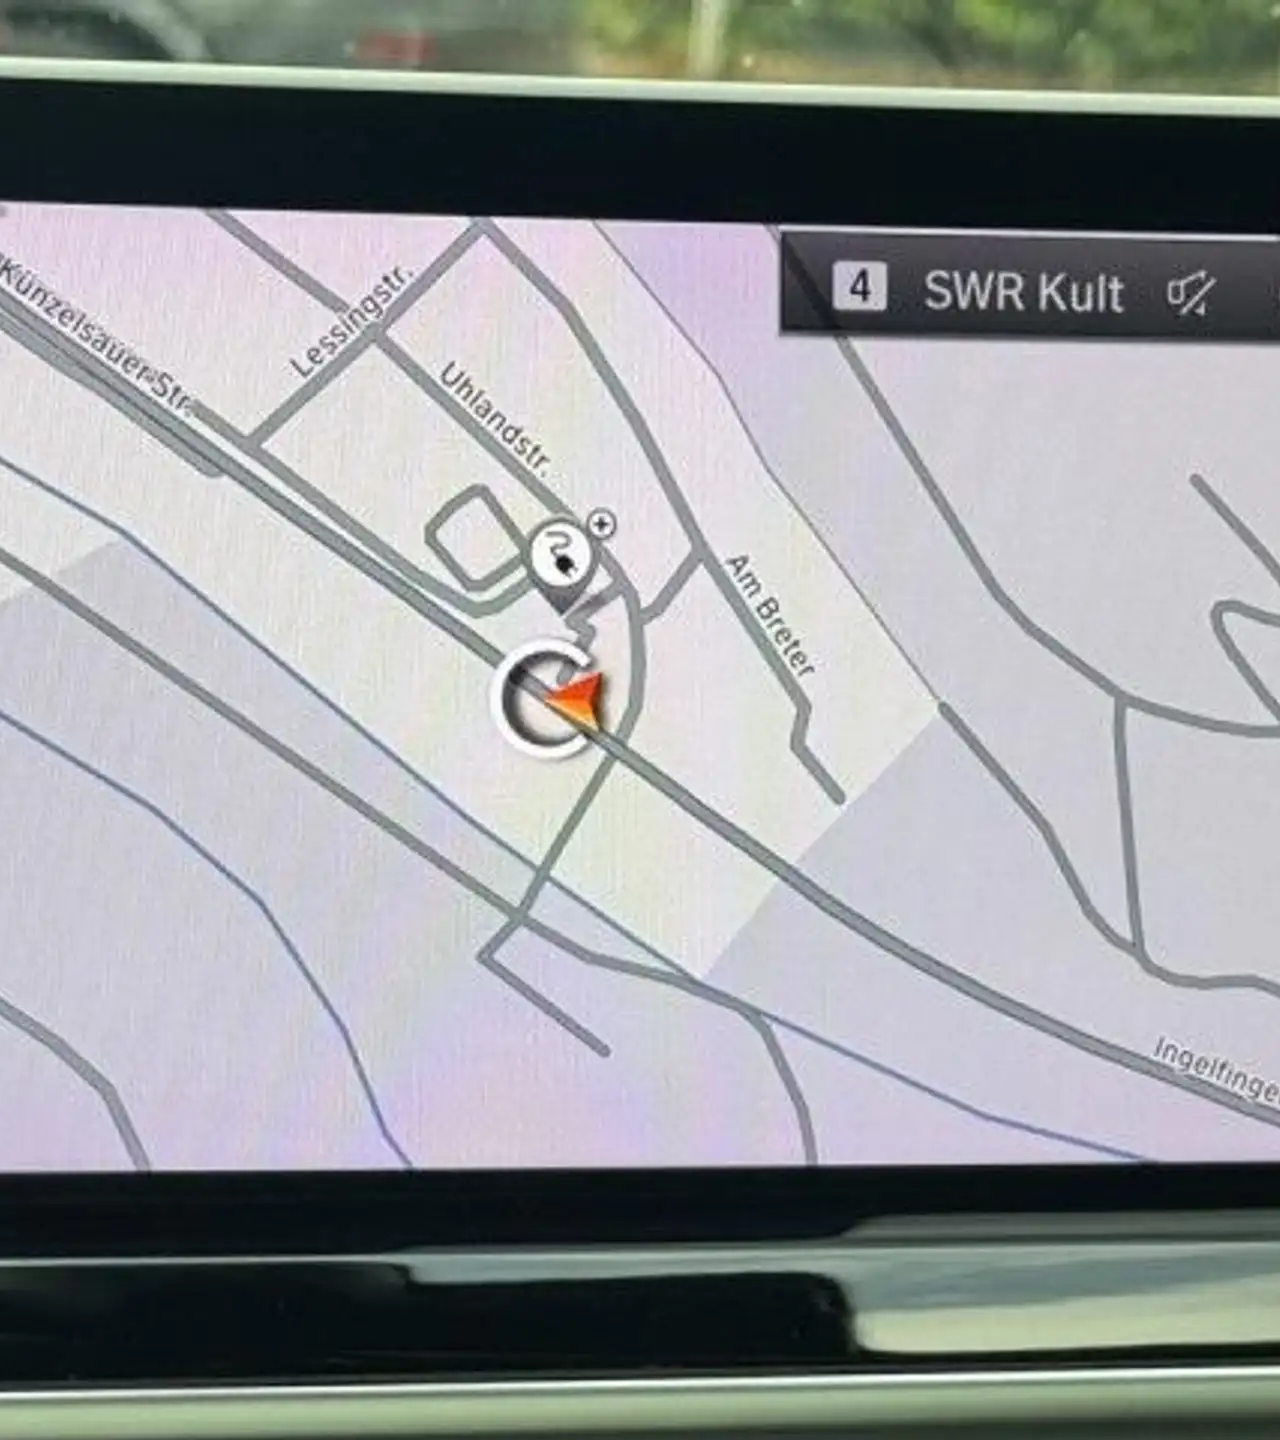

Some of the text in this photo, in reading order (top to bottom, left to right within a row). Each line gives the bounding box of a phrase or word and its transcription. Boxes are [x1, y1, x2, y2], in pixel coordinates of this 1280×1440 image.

[289, 264, 415, 379] Lessingstr.
[849, 268, 1125, 314] 4 SWR Kult
[439, 360, 552, 477] Uhlandstr.
[725, 552, 816, 680] Am Breter
